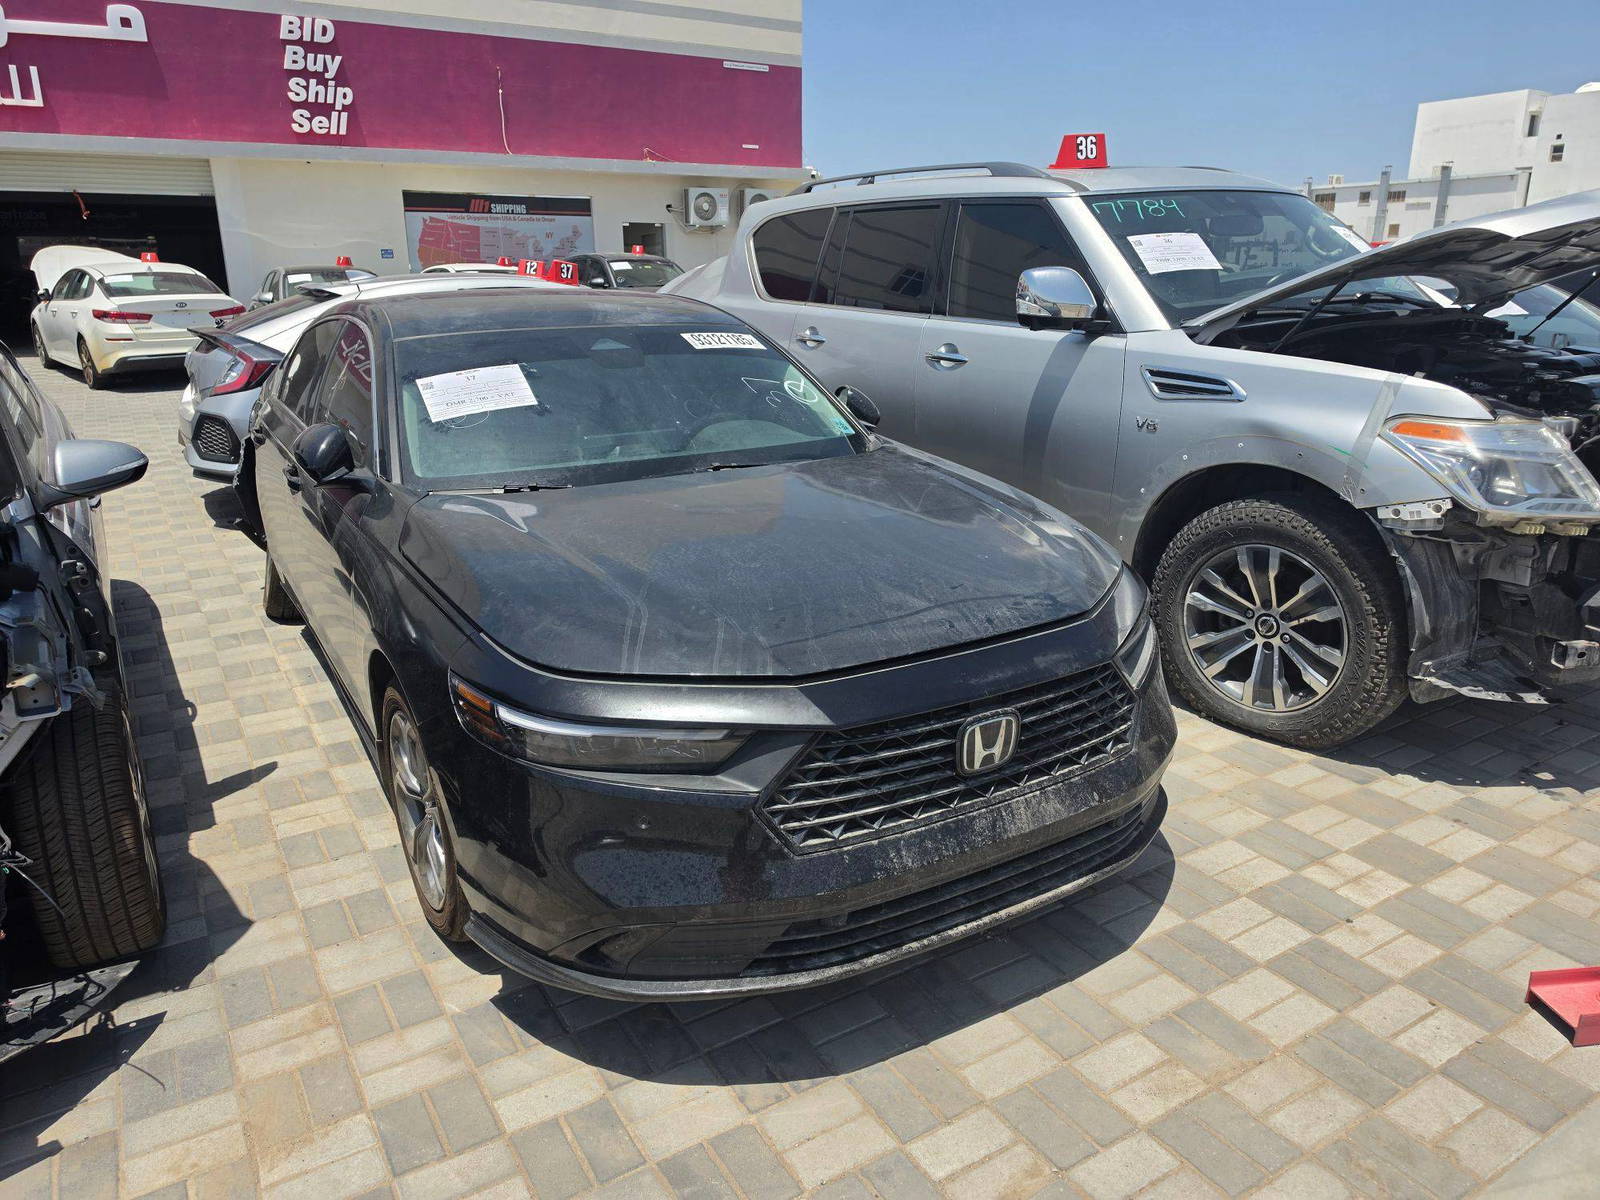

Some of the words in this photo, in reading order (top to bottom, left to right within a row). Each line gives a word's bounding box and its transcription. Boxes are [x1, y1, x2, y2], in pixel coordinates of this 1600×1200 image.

[280, 15, 335, 43] BID
[284, 45, 342, 79] Buy
[287, 77, 354, 110] Ship
[291, 109, 348, 135] Sell
[1076, 136, 1097, 160] 36
[490, 203, 527, 214] SHIPPING
[1092, 199, 1186, 222] 7784
[545, 231, 554, 240] NY
[525, 261, 538, 275] 12
[560, 263, 573, 279] 37
